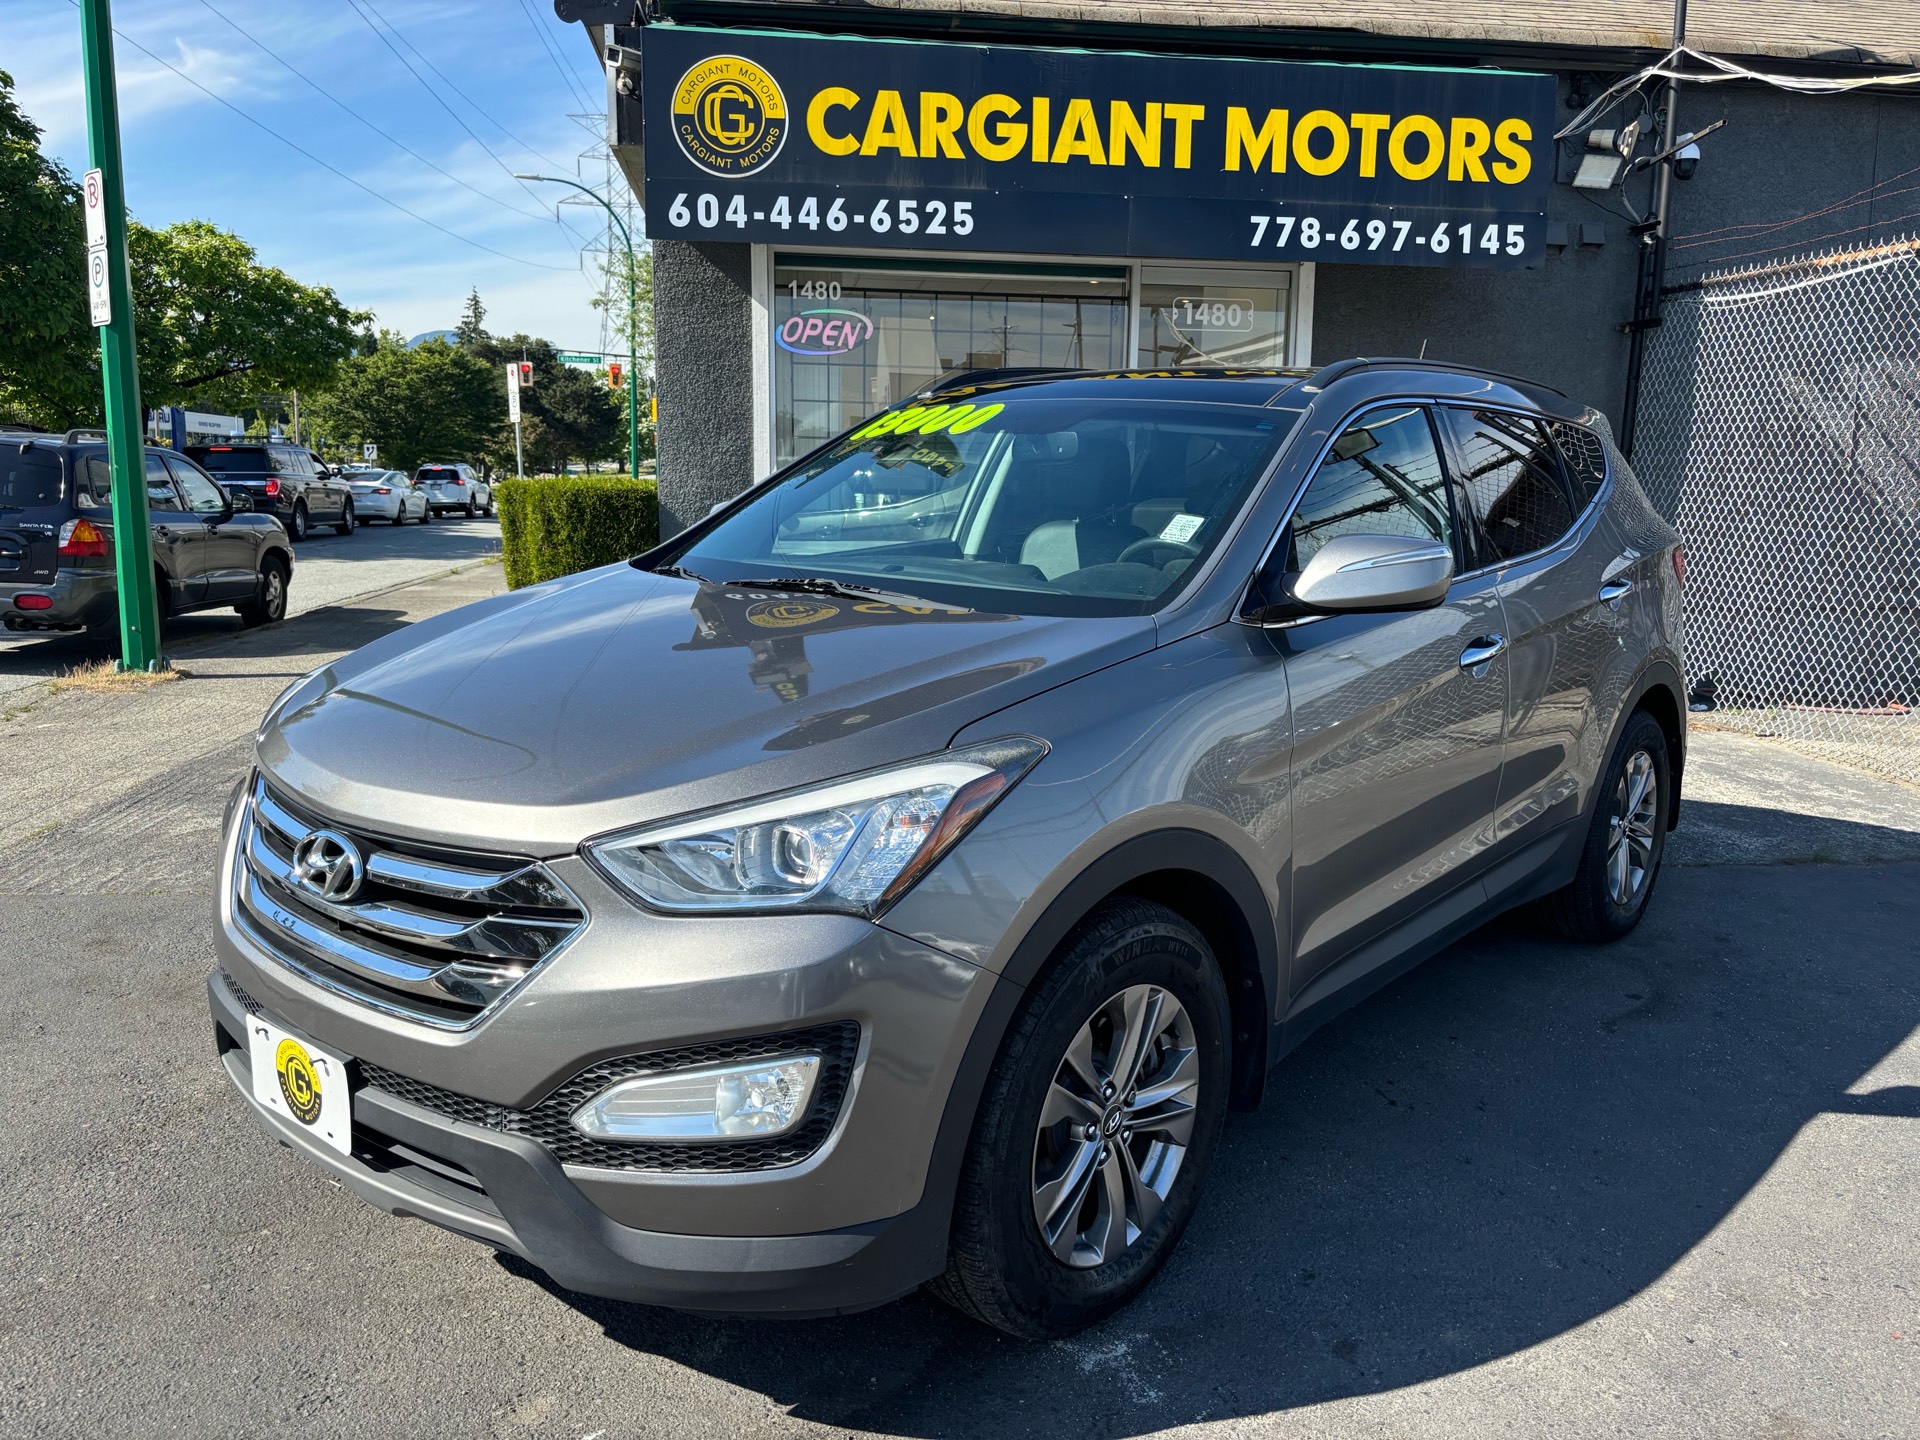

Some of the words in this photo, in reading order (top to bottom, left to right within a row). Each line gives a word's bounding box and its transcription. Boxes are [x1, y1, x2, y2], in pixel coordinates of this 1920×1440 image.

[681, 64, 731, 105] CARGIANT
[738, 66, 778, 111] MOTORS
[681, 124, 733, 169] CARGIANT
[739, 127, 780, 168] MOTORS
[806, 86, 1205, 169] CARGIANT
[1224, 106, 1533, 185] MOTORS
[668, 193, 974, 236] 604-446-6525
[1250, 215, 1525, 256] 778-697-6145
[788, 280, 842, 301] 1480
[782, 316, 862, 350] OPEN
[1183, 302, 1242, 327] 1480
